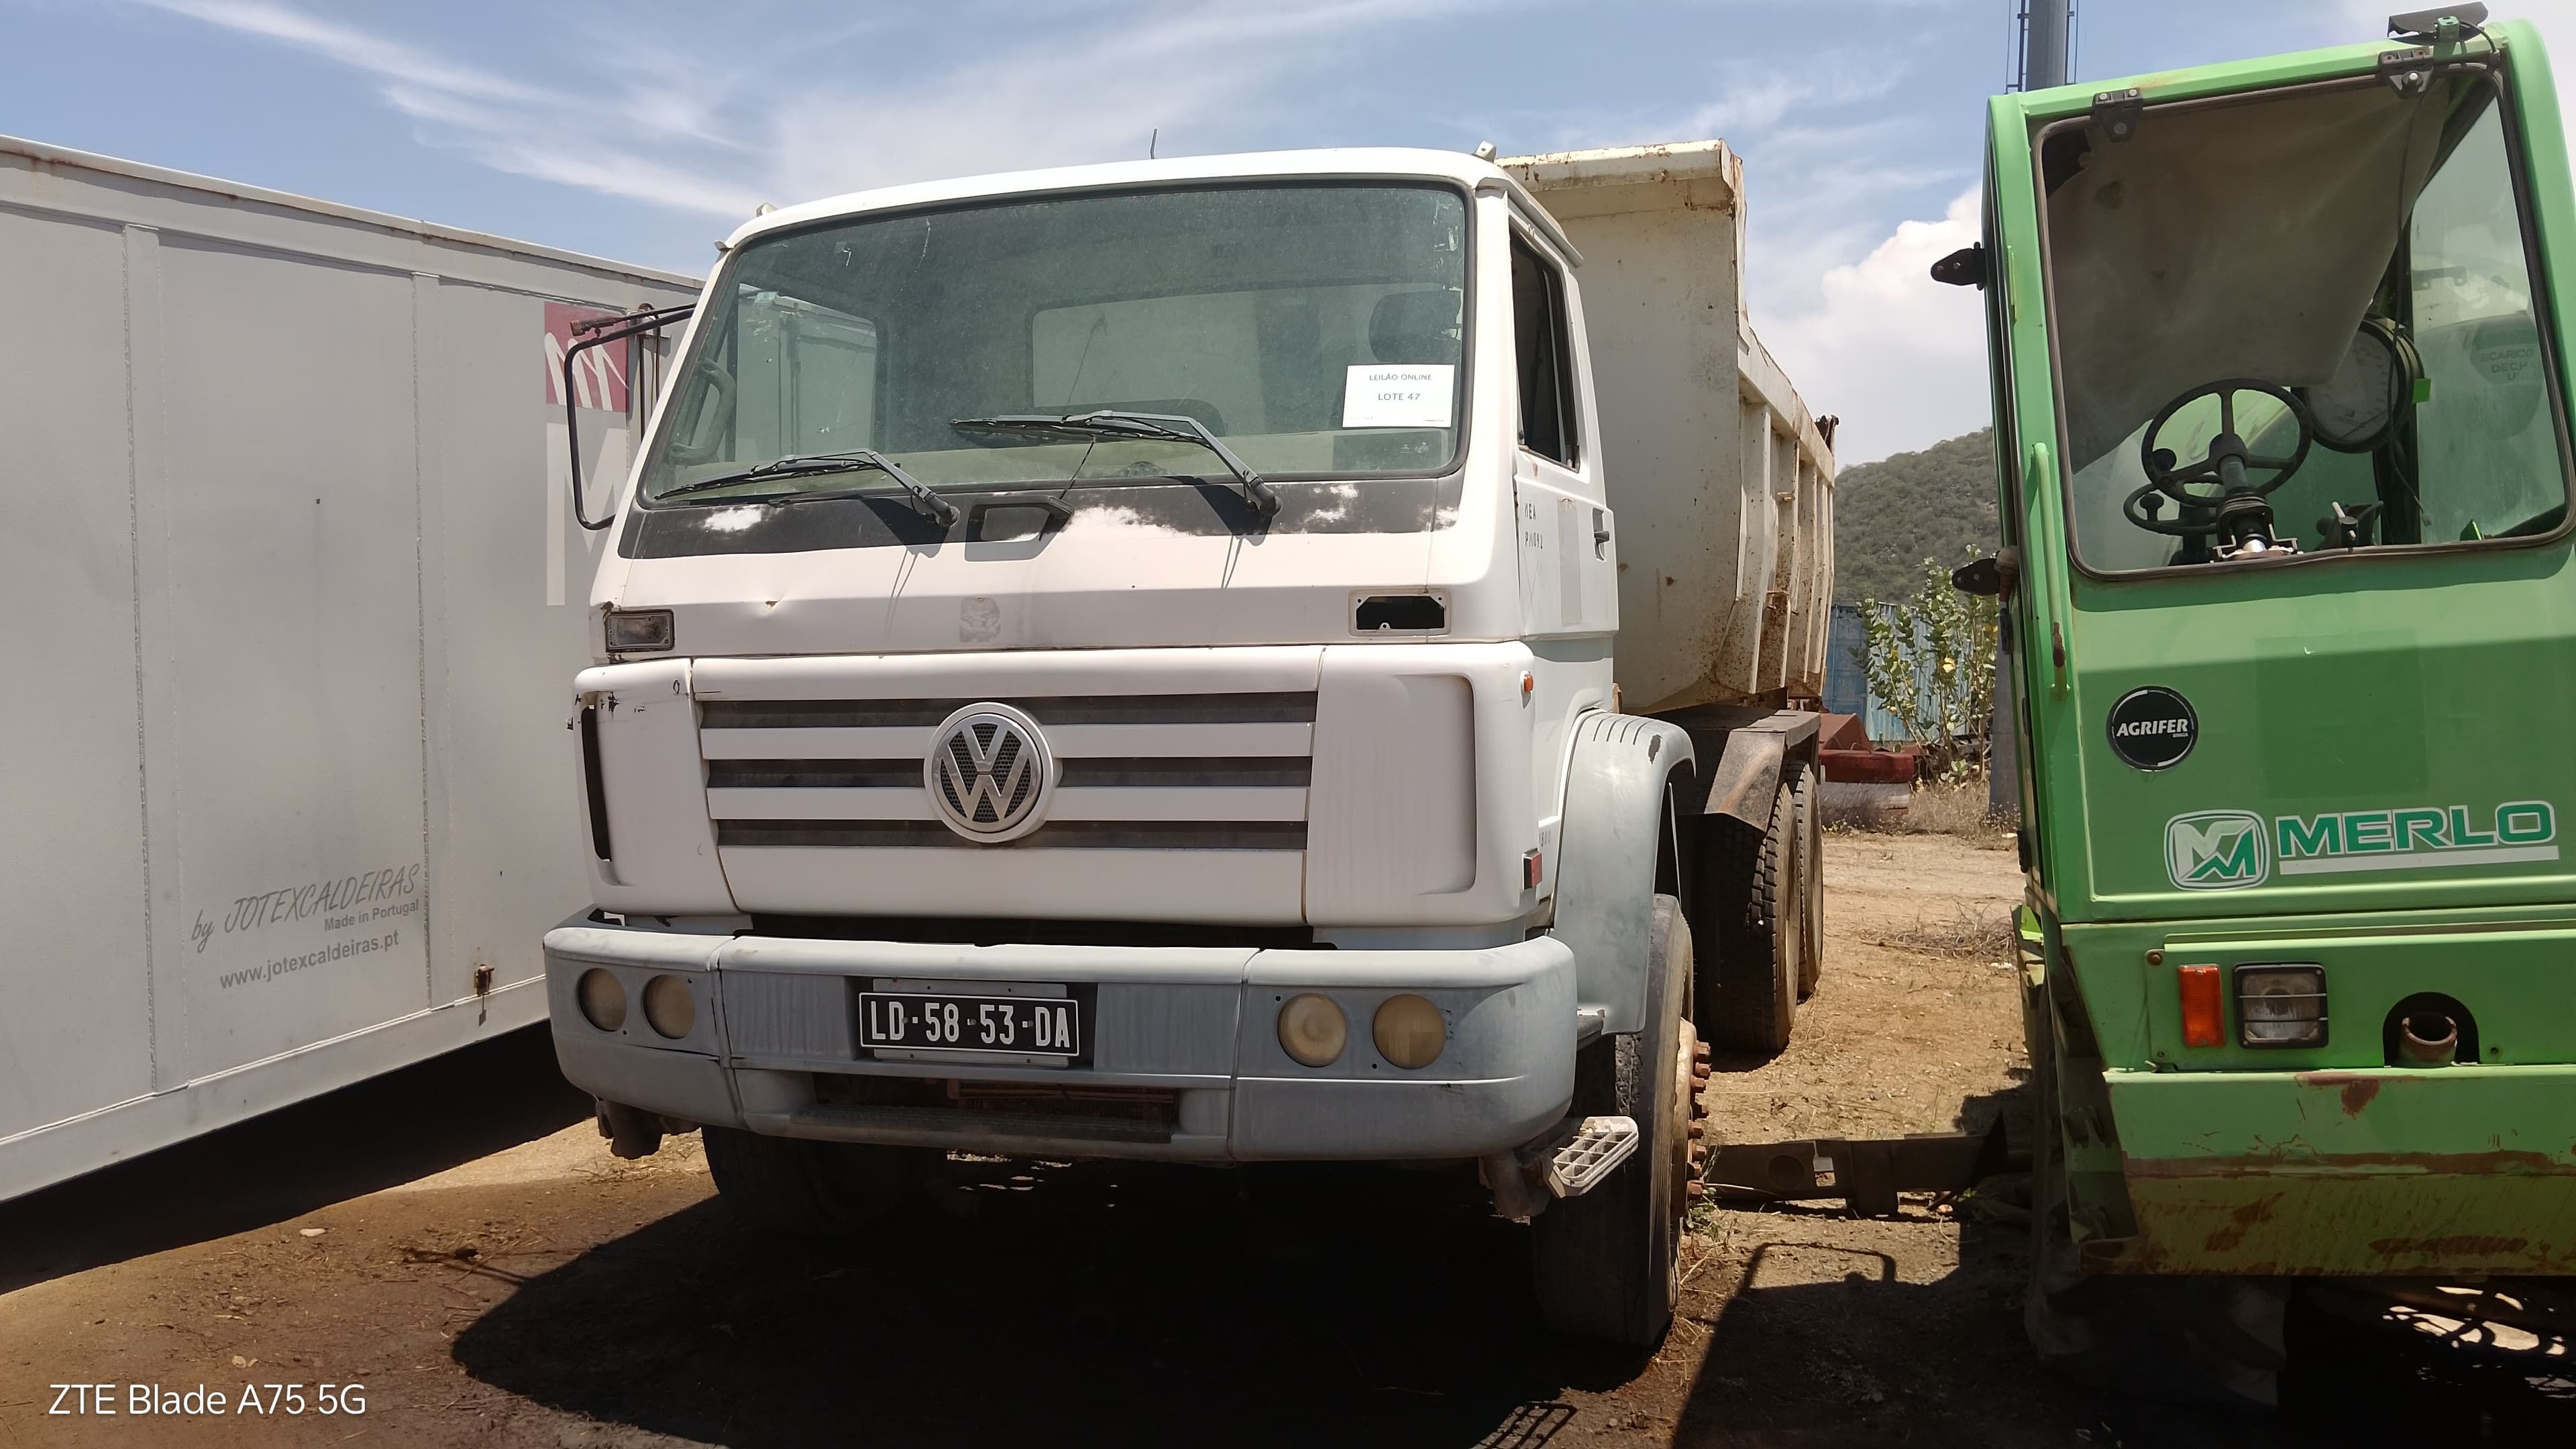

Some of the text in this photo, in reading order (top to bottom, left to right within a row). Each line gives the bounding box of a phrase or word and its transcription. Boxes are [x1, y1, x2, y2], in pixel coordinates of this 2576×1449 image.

[2116, 718, 2188, 737] AGRIFER
[932, 714, 1042, 833] VW
[2275, 800, 2557, 859] MERLO
[191, 863, 420, 953] by JOTEXCALDEIRAS
[324, 899, 419, 932] Made in Portugal
[220, 930, 399, 989] www.jotexcaldeiras.pt
